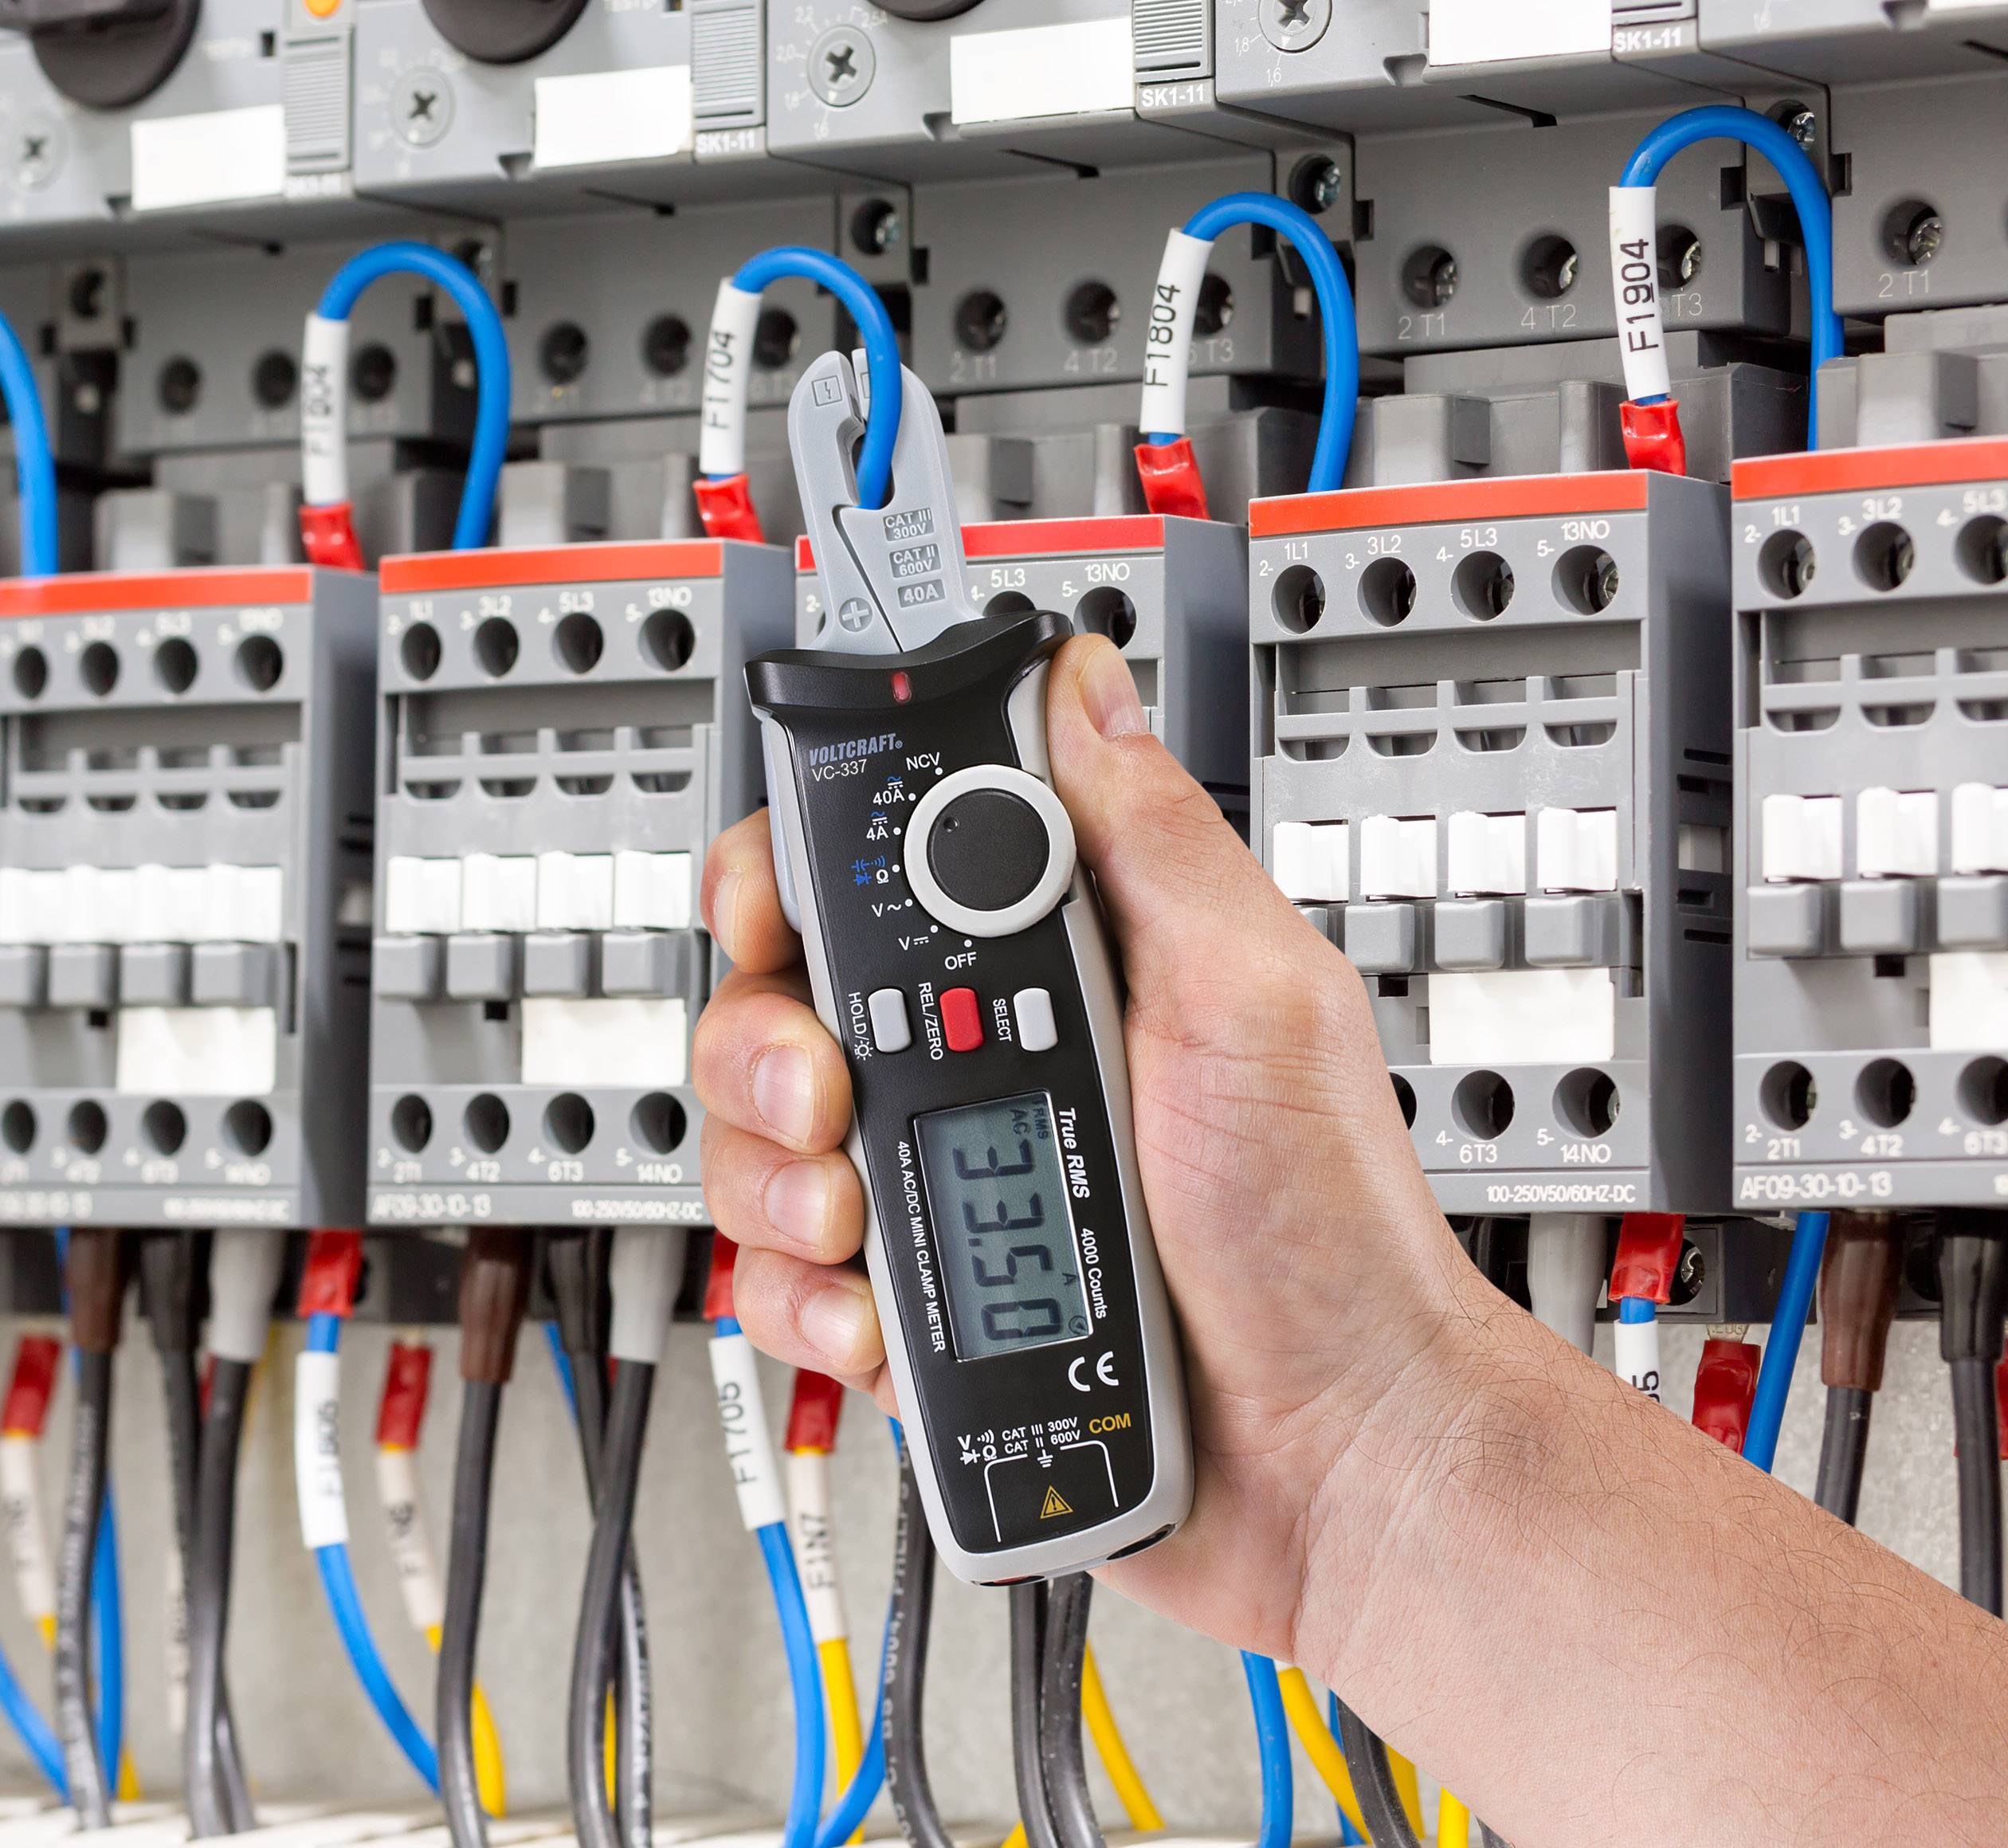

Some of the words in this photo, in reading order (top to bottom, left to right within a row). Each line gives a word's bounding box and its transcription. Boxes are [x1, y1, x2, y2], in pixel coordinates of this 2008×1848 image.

[1235, 37, 1249, 57] 1,8
[1613, 26, 1682, 53] SK1-11
[1266, 67, 1282, 88] 1,6
[1141, 84, 1206, 108] SK1-11
[1620, 238, 1659, 352] F1904
[1144, 284, 1181, 386] F1804
[885, 512, 916, 530] CAT
[918, 508, 932, 523] III
[893, 523, 927, 540] 300V
[1561, 520, 1610, 541] 13NO
[893, 547, 925, 565] CAT
[927, 544, 936, 558] II
[1284, 542, 1308, 561] 1L1
[1436, 547, 1454, 563] 4-
[1536, 540, 1555, 557] 5-
[899, 559, 933, 575] 600V
[1084, 562, 1130, 583] 13NO
[1259, 559, 1274, 577] 2-
[1345, 554, 1361, 571] 3-
[903, 583, 940, 604] 40A
[1061, 580, 1079, 598] 5-
[811, 758, 868, 782] VC-337
[906, 751, 941, 771] NCV
[873, 787, 904, 806] 40A
[866, 825, 889, 841] 4A
[944, 951, 977, 970] OFF
[918, 981, 944, 1061] REL/ZERO
[992, 997, 1012, 1042] SELECT
[1009, 1108, 1030, 1135] AC
[1058, 1107, 1077, 1149] True
[1435, 1129, 1454, 1146] 4-
[1536, 1128, 1555, 1146] 5-
[897, 1140, 912, 1168] 40A
[1559, 1143, 1612, 1163] 14NO
[1066, 1154, 1091, 1199] RMS
[901, 1169, 921, 1215] AC/DC
[909, 1216, 928, 1248] MINI
[1080, 1227, 1100, 1265] 4000
[916, 1249, 937, 1300] CLAMP
[1088, 1267, 1108, 1320] Counts
[925, 1301, 947, 1353] METER
[717, 1382, 758, 1485] F1705
[1002, 1426, 1026, 1442] CAT
[1030, 1423, 1044, 1436] III
[1047, 1416, 1078, 1433] 300V
[1088, 1412, 1132, 1434] COM
[1004, 1439, 1029, 1455] CAT
[1035, 1437, 1045, 1449] II
[1050, 1429, 1081, 1446] 600V
